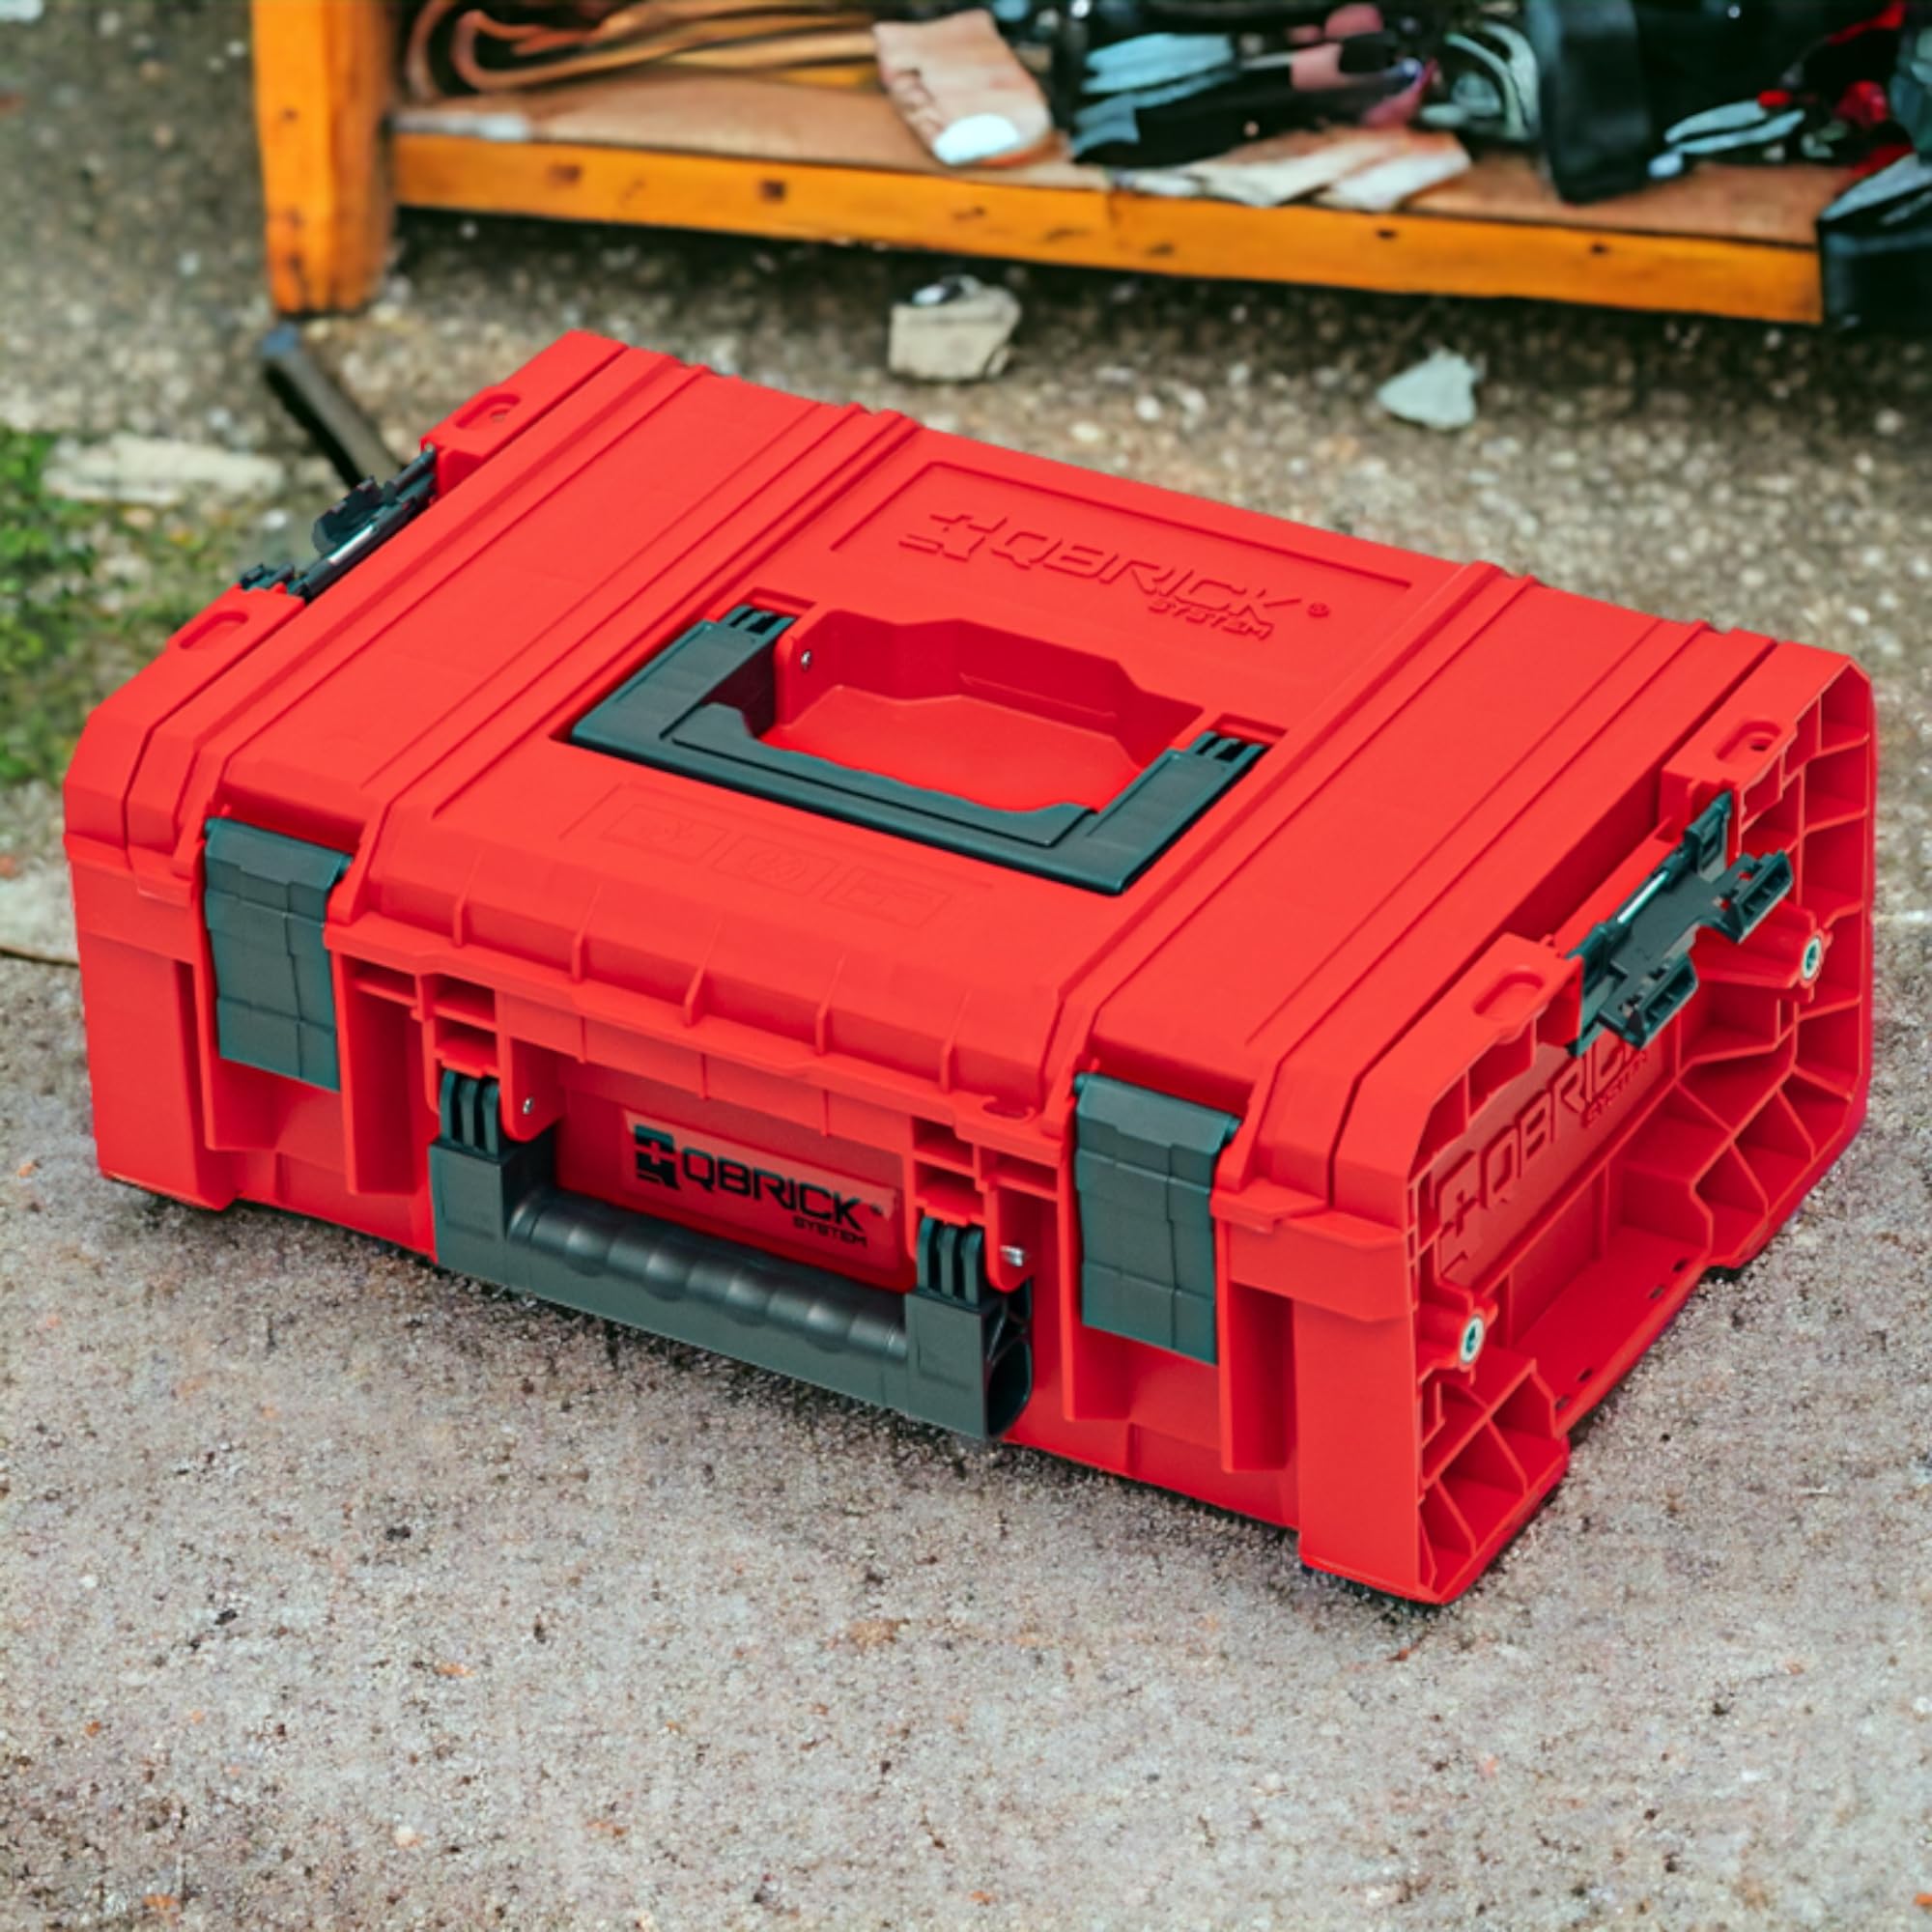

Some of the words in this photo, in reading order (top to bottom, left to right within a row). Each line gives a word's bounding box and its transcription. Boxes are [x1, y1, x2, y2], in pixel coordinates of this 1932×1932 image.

[1480, 1026, 1634, 1210] QBRIC
[682, 1147, 864, 1232] QBRICK
[792, 1215, 867, 1247] SYSTEM
